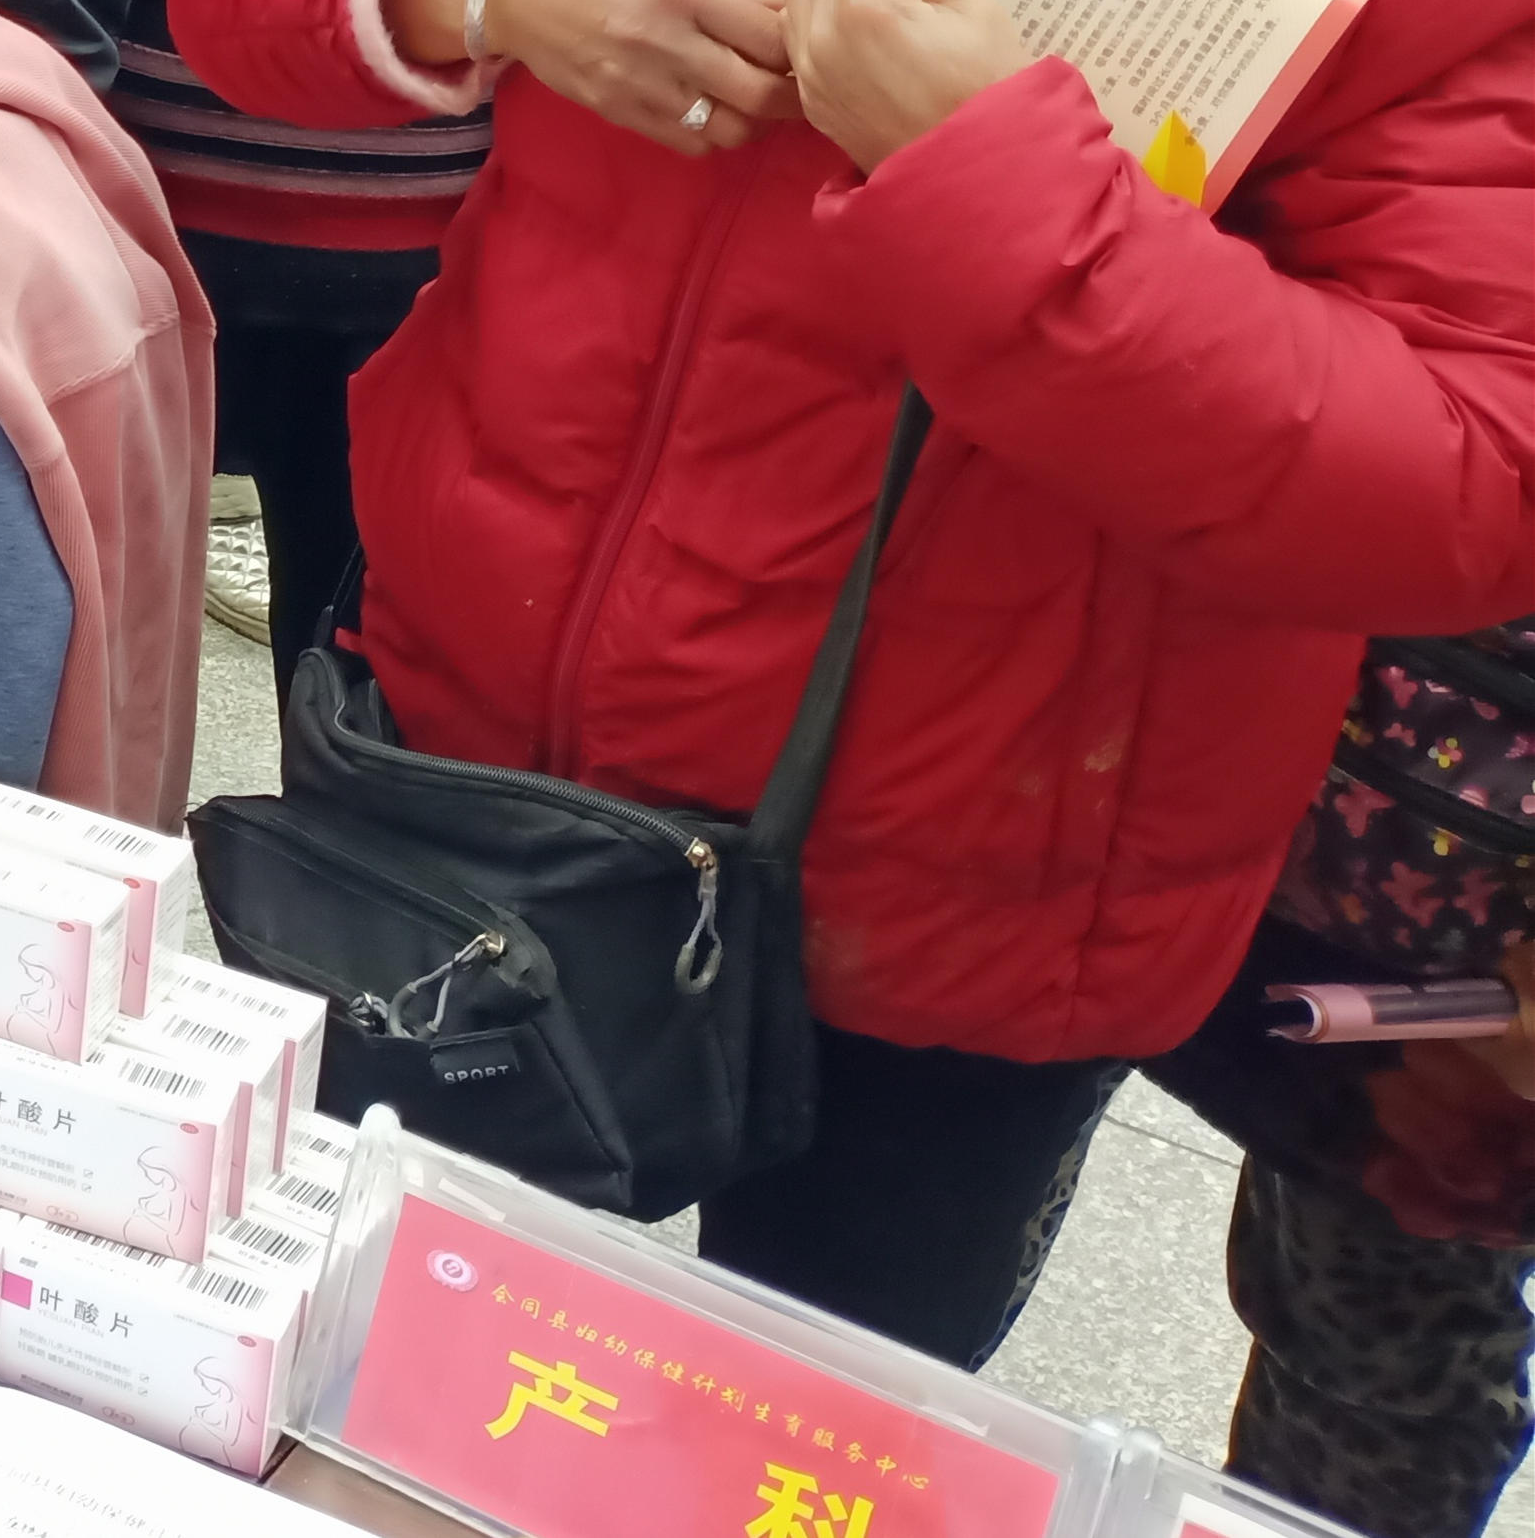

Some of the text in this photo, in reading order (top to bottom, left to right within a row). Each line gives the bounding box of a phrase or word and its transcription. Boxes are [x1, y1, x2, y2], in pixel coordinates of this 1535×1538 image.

[39, 1287, 133, 1338] 叶酸片
[491, 1282, 930, 1491] 会同县妇幼保健计划生育服务中心
